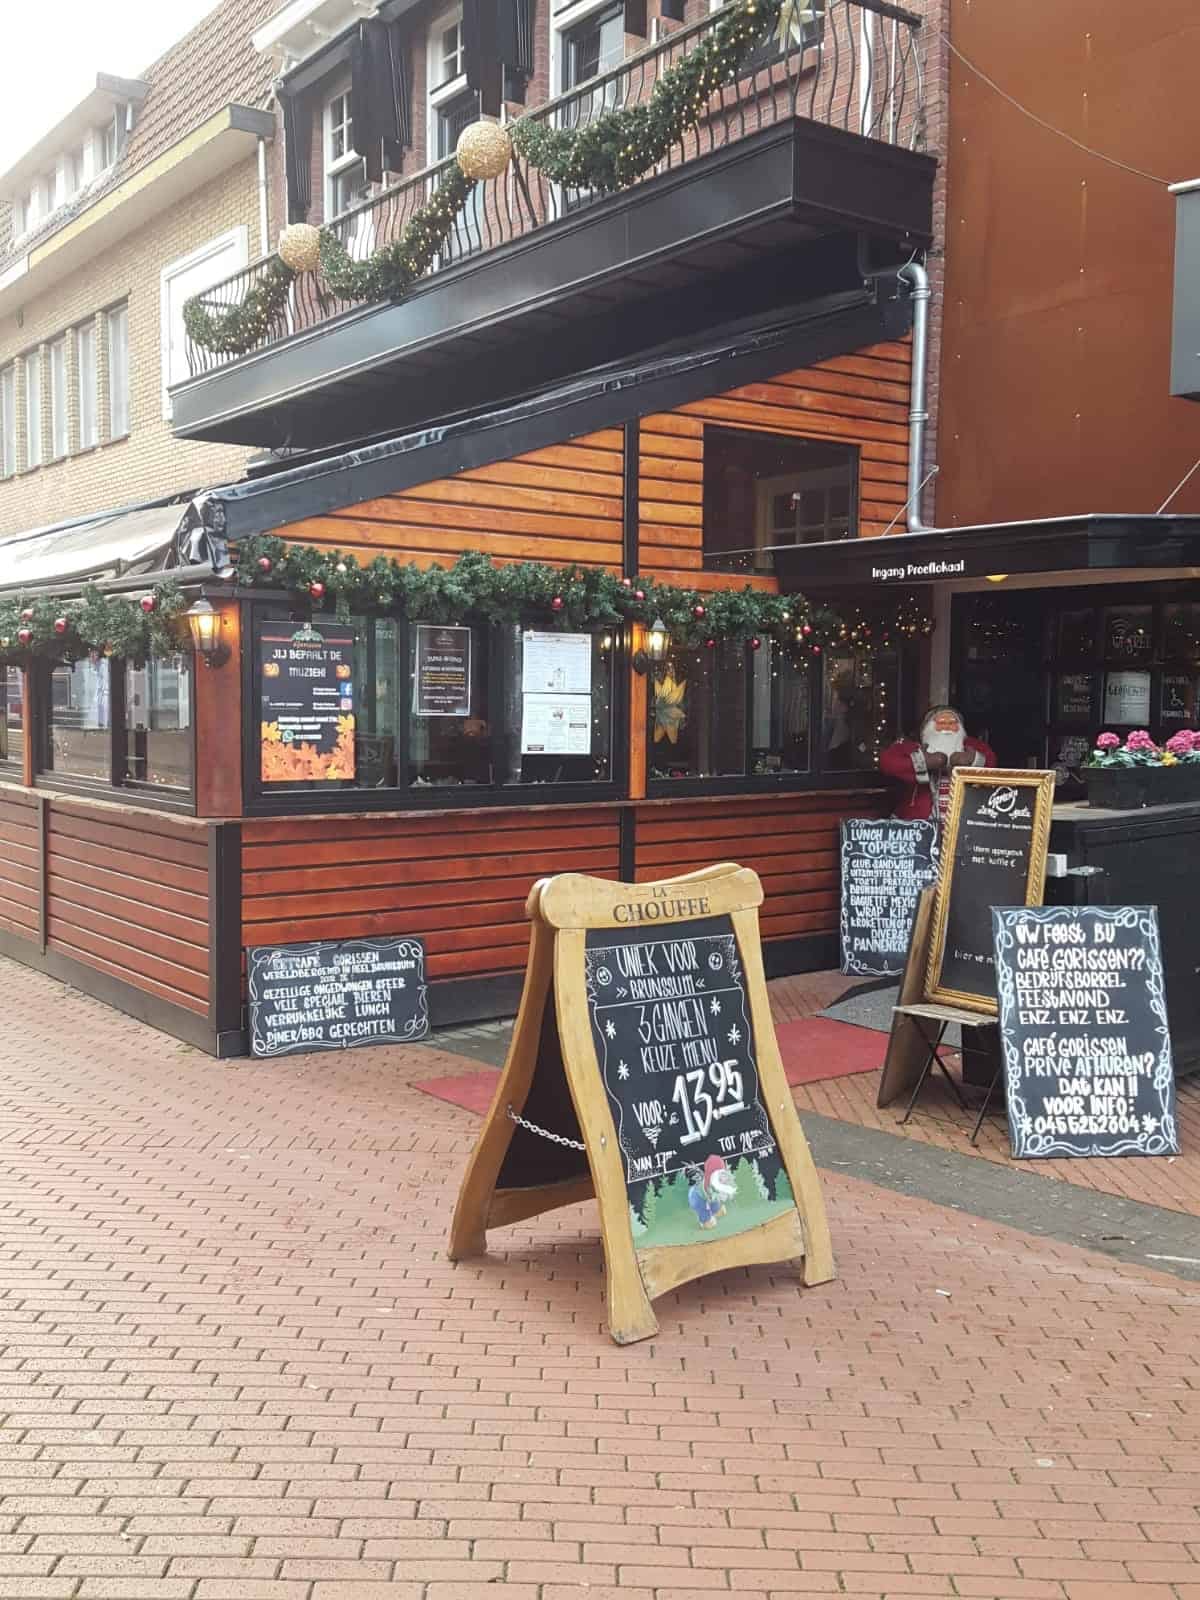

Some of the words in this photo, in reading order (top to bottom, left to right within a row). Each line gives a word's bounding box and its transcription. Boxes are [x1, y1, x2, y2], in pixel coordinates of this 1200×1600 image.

[872, 567, 905, 580] Ingang
[907, 559, 965, 575] Proeflokaal
[289, 650, 327, 661] BEPAALT
[330, 651, 342, 661] DE
[851, 829, 882, 841] LUNCH
[859, 841, 916, 854] TOPPERS
[852, 859, 871, 868] CLUB
[872, 859, 914, 870] SANDWICH
[653, 887, 667, 898] LA
[850, 895, 888, 907] BAGUETTE
[891, 896, 916, 908] MEXIC
[613, 897, 711, 923] CHOUFFE
[855, 906, 883, 918] WRAP
[890, 907, 909, 918] KIP
[1016, 923, 1040, 944] UW
[854, 937, 909, 952] PANNENKOE
[616, 944, 659, 978] UNIEK
[662, 941, 699, 973] VOOR
[263, 986, 311, 1000] GEZELLIGE
[274, 998, 298, 1011] VELE
[356, 1002, 390, 1017] LUNCH
[634, 1005, 652, 1043] 3
[652, 999, 709, 1042] GANGEN
[1019, 1010, 1056, 1024] ENZ.
[1096, 1010, 1129, 1024] ENZ.
[329, 1019, 396, 1038] GERECHTEN
[640, 1044, 679, 1073] KEUZE
[681, 1037, 718, 1068] MENU
[1094, 1077, 1125, 1096] KAN
[1043, 1097, 1085, 1115] VOOR
[1090, 1095, 1135, 1115] INFO:
[632, 1100, 668, 1127] VOOR:
[717, 1135, 736, 1152] TOT
[633, 1155, 652, 1171] VAN
